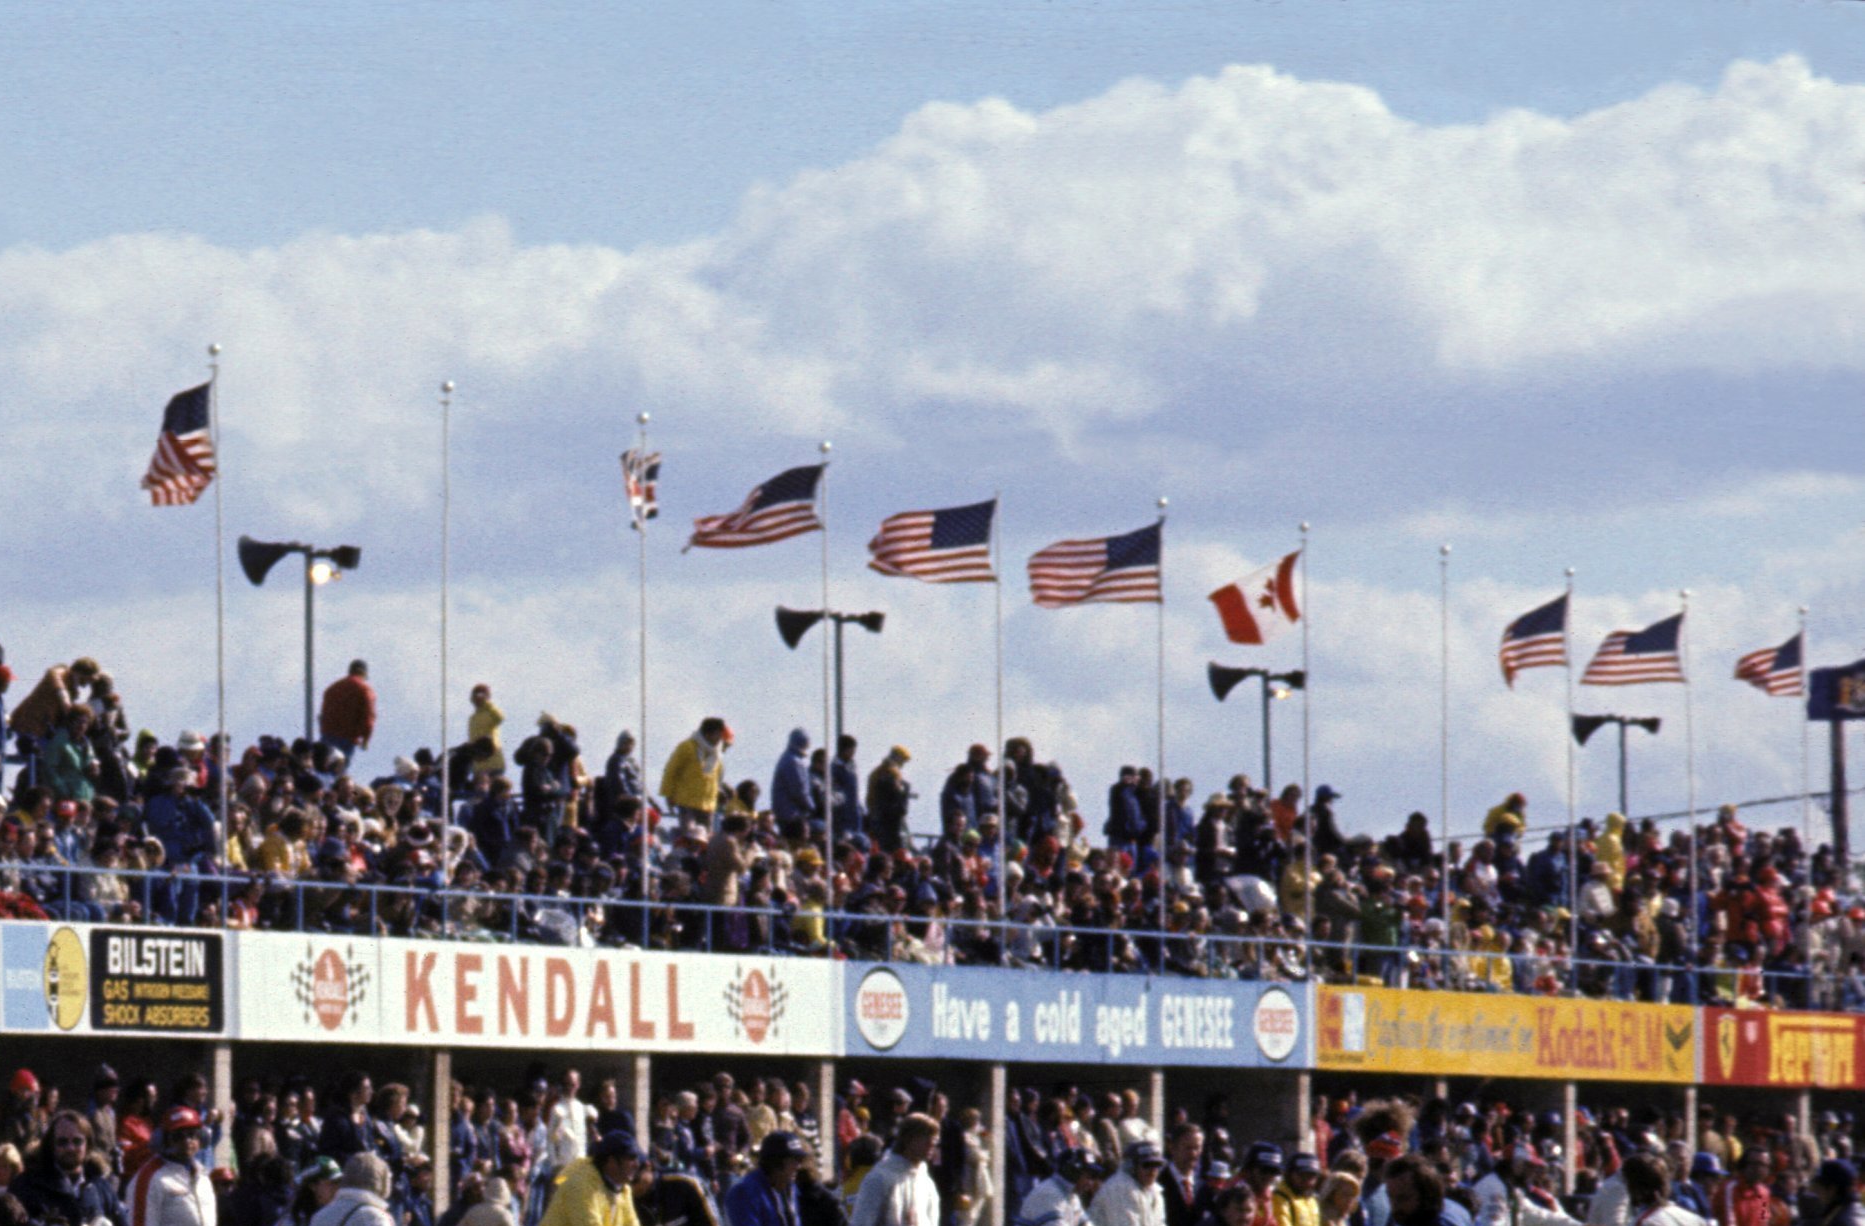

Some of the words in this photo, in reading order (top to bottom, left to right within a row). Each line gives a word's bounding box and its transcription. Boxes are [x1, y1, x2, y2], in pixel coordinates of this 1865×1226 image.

[107, 936, 206, 977] BILSTEIN
[103, 979, 130, 1001] GAS
[103, 1003, 141, 1025] SHOCK
[405, 950, 696, 1041] KENDALL
[931, 982, 991, 1041] Have
[1004, 1000, 1020, 1043] a
[1034, 990, 1082, 1045] cold
[1095, 994, 1148, 1058] aged
[1160, 993, 1234, 1049] GENESEE
[1537, 1006, 1617, 1069] Kodak
